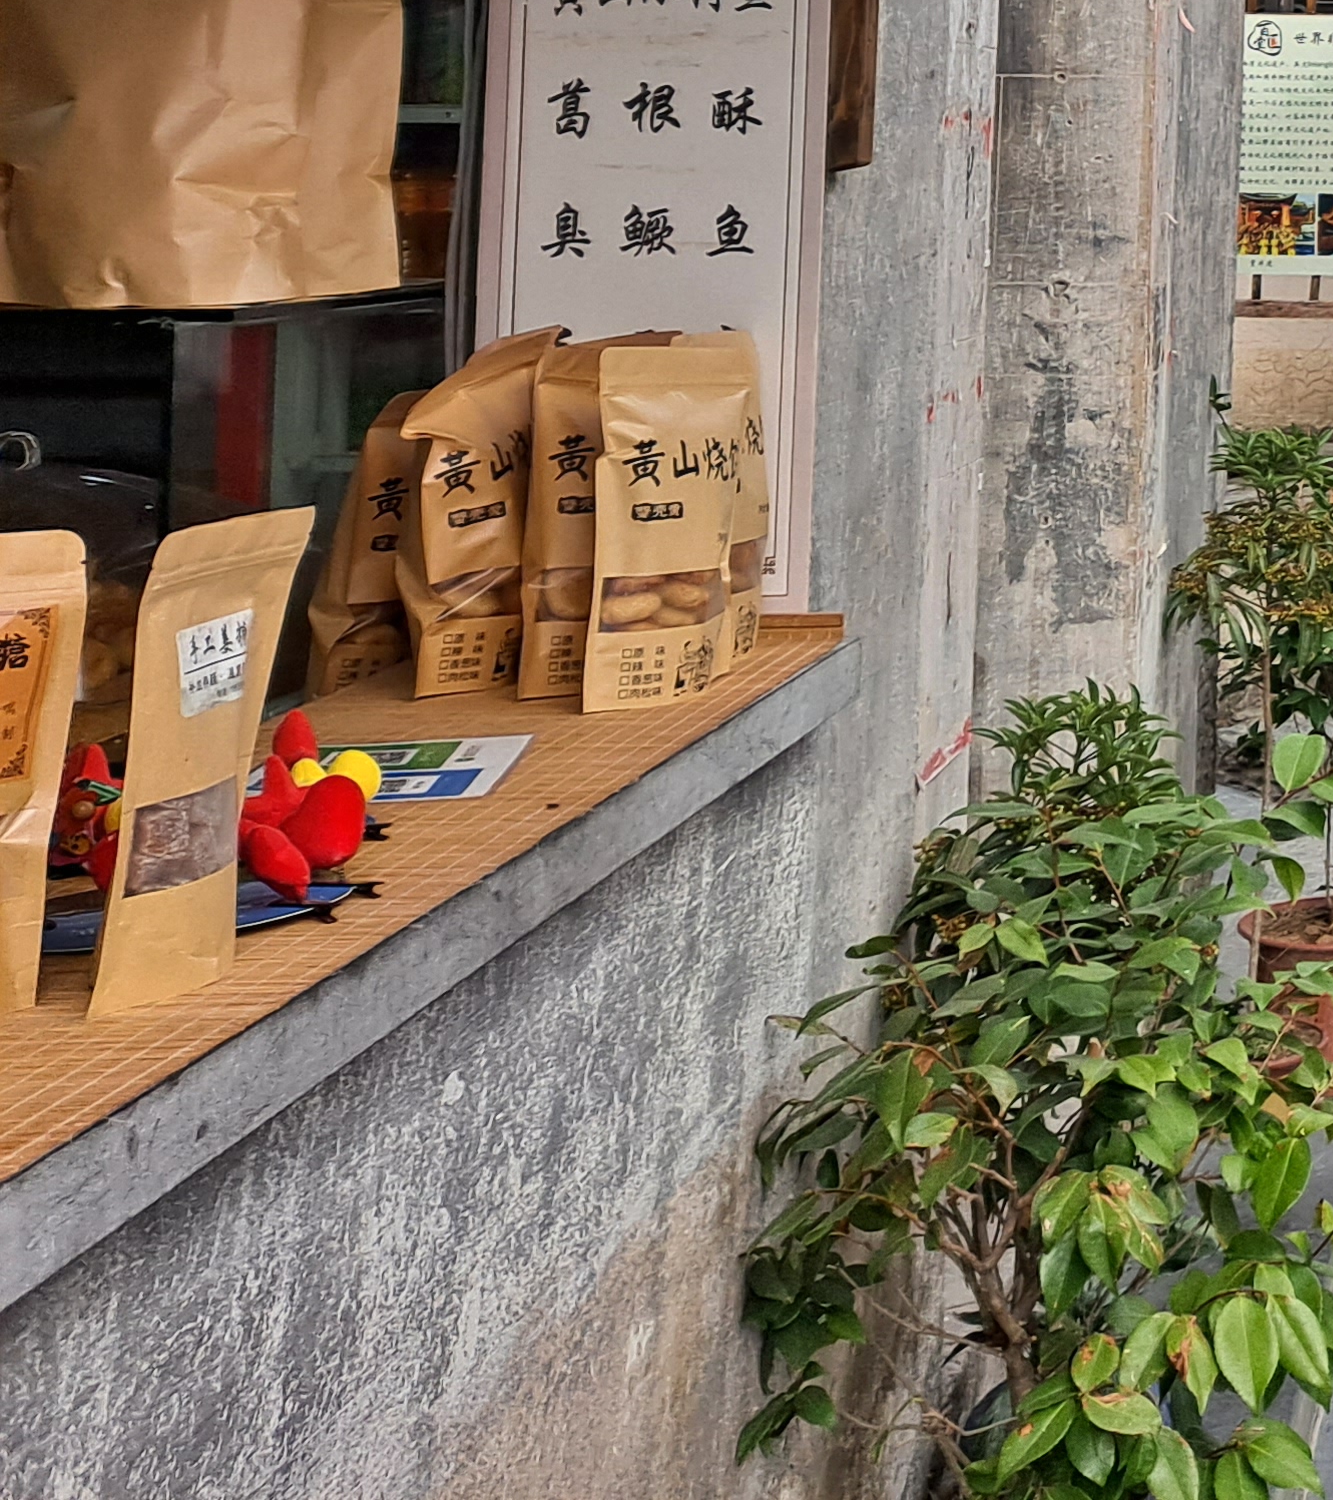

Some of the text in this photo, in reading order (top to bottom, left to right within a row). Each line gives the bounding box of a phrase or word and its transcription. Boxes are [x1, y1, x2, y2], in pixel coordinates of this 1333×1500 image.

[547, 77, 763, 139] 葛根酥
[541, 202, 754, 258] 臭鳜鱼
